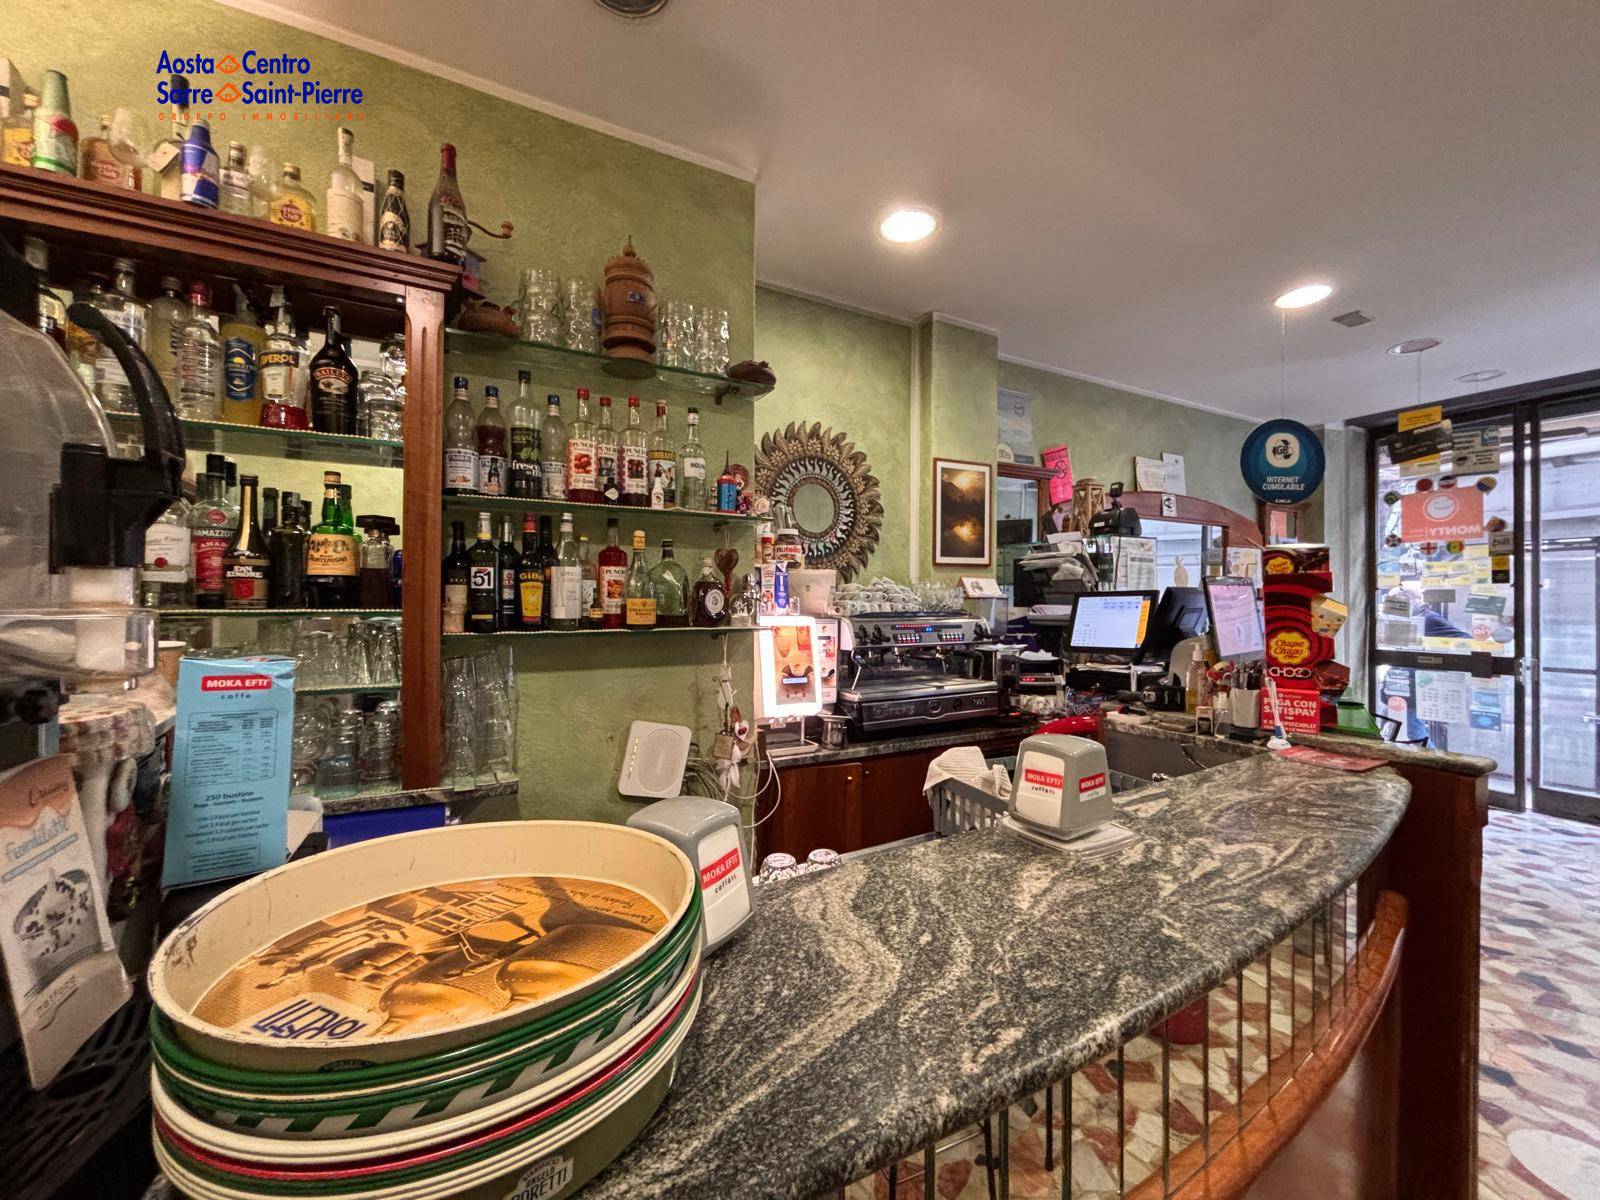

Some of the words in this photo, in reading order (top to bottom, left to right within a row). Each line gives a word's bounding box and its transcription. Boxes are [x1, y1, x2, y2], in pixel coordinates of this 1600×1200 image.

[1262, 483, 1305, 491] CUMULABILE
[472, 571, 491, 587] 51
[1274, 639, 1304, 649] Chupa
[1273, 645, 1304, 655] Chups
[1269, 667, 1312, 678] CHOCO
[206, 679, 242, 688] MOKA
[244, 678, 270, 687] EFTI
[1264, 697, 1292, 708] PGA
[1295, 699, 1317, 709] CON
[1263, 705, 1317, 717] STISPAY
[702, 863, 726, 884] MOKA
[724, 854, 738, 869] EFTI
